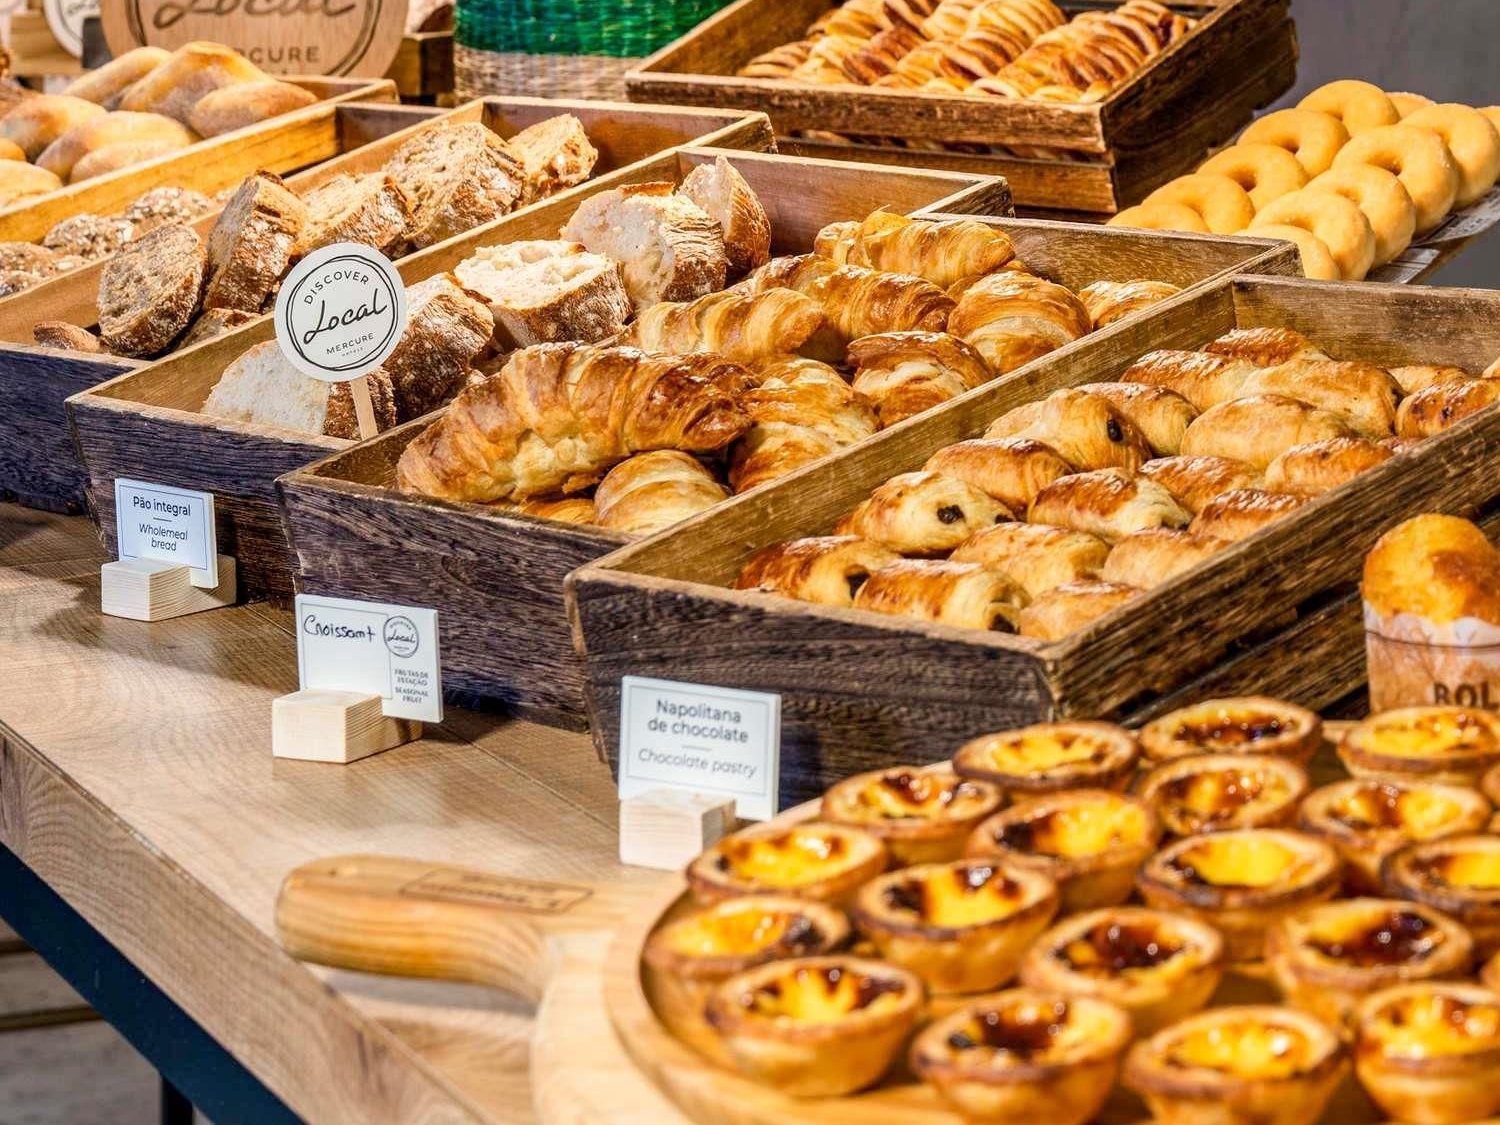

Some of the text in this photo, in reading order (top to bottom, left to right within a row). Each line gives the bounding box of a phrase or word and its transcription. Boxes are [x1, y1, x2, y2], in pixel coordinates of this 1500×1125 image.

[236, 46, 319, 63] CURE
[304, 270, 370, 305] DISCOVER
[303, 288, 388, 344] Local
[326, 332, 375, 355] MERCURE
[133, 495, 191, 517] Pão integral
[139, 523, 188, 541] Wholemeal
[151, 538, 177, 552] bread
[656, 699, 742, 724] Napolitana
[648, 717, 749, 743] de chocolate
[638, 747, 757, 778] Chocolate pastry
